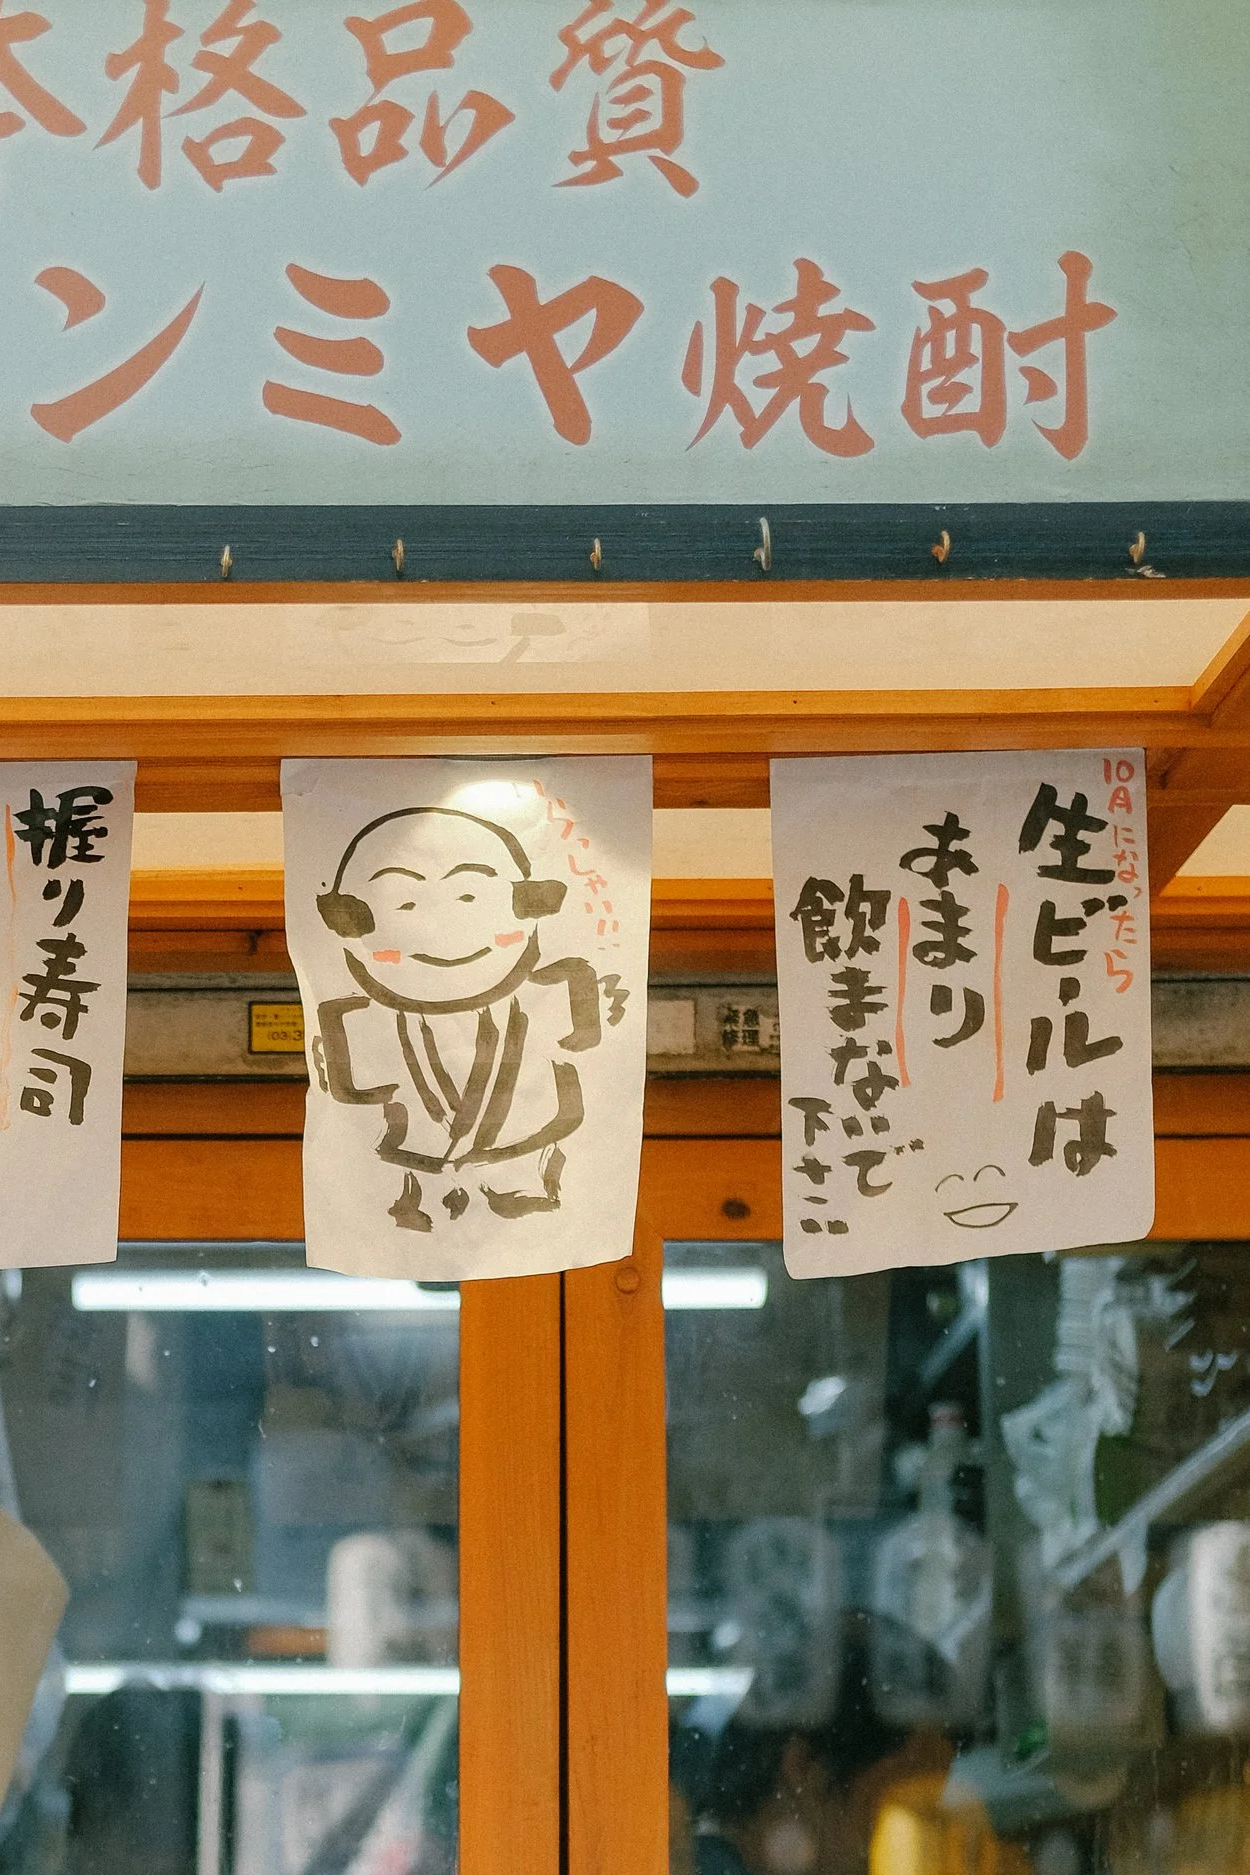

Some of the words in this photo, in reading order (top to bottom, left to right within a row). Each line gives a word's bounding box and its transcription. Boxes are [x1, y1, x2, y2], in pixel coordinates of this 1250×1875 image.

[13, 785, 114, 1126] 握り寿司
[899, 810, 986, 1049] あまり
[1019, 782, 1129, 1177] 生ビールは
